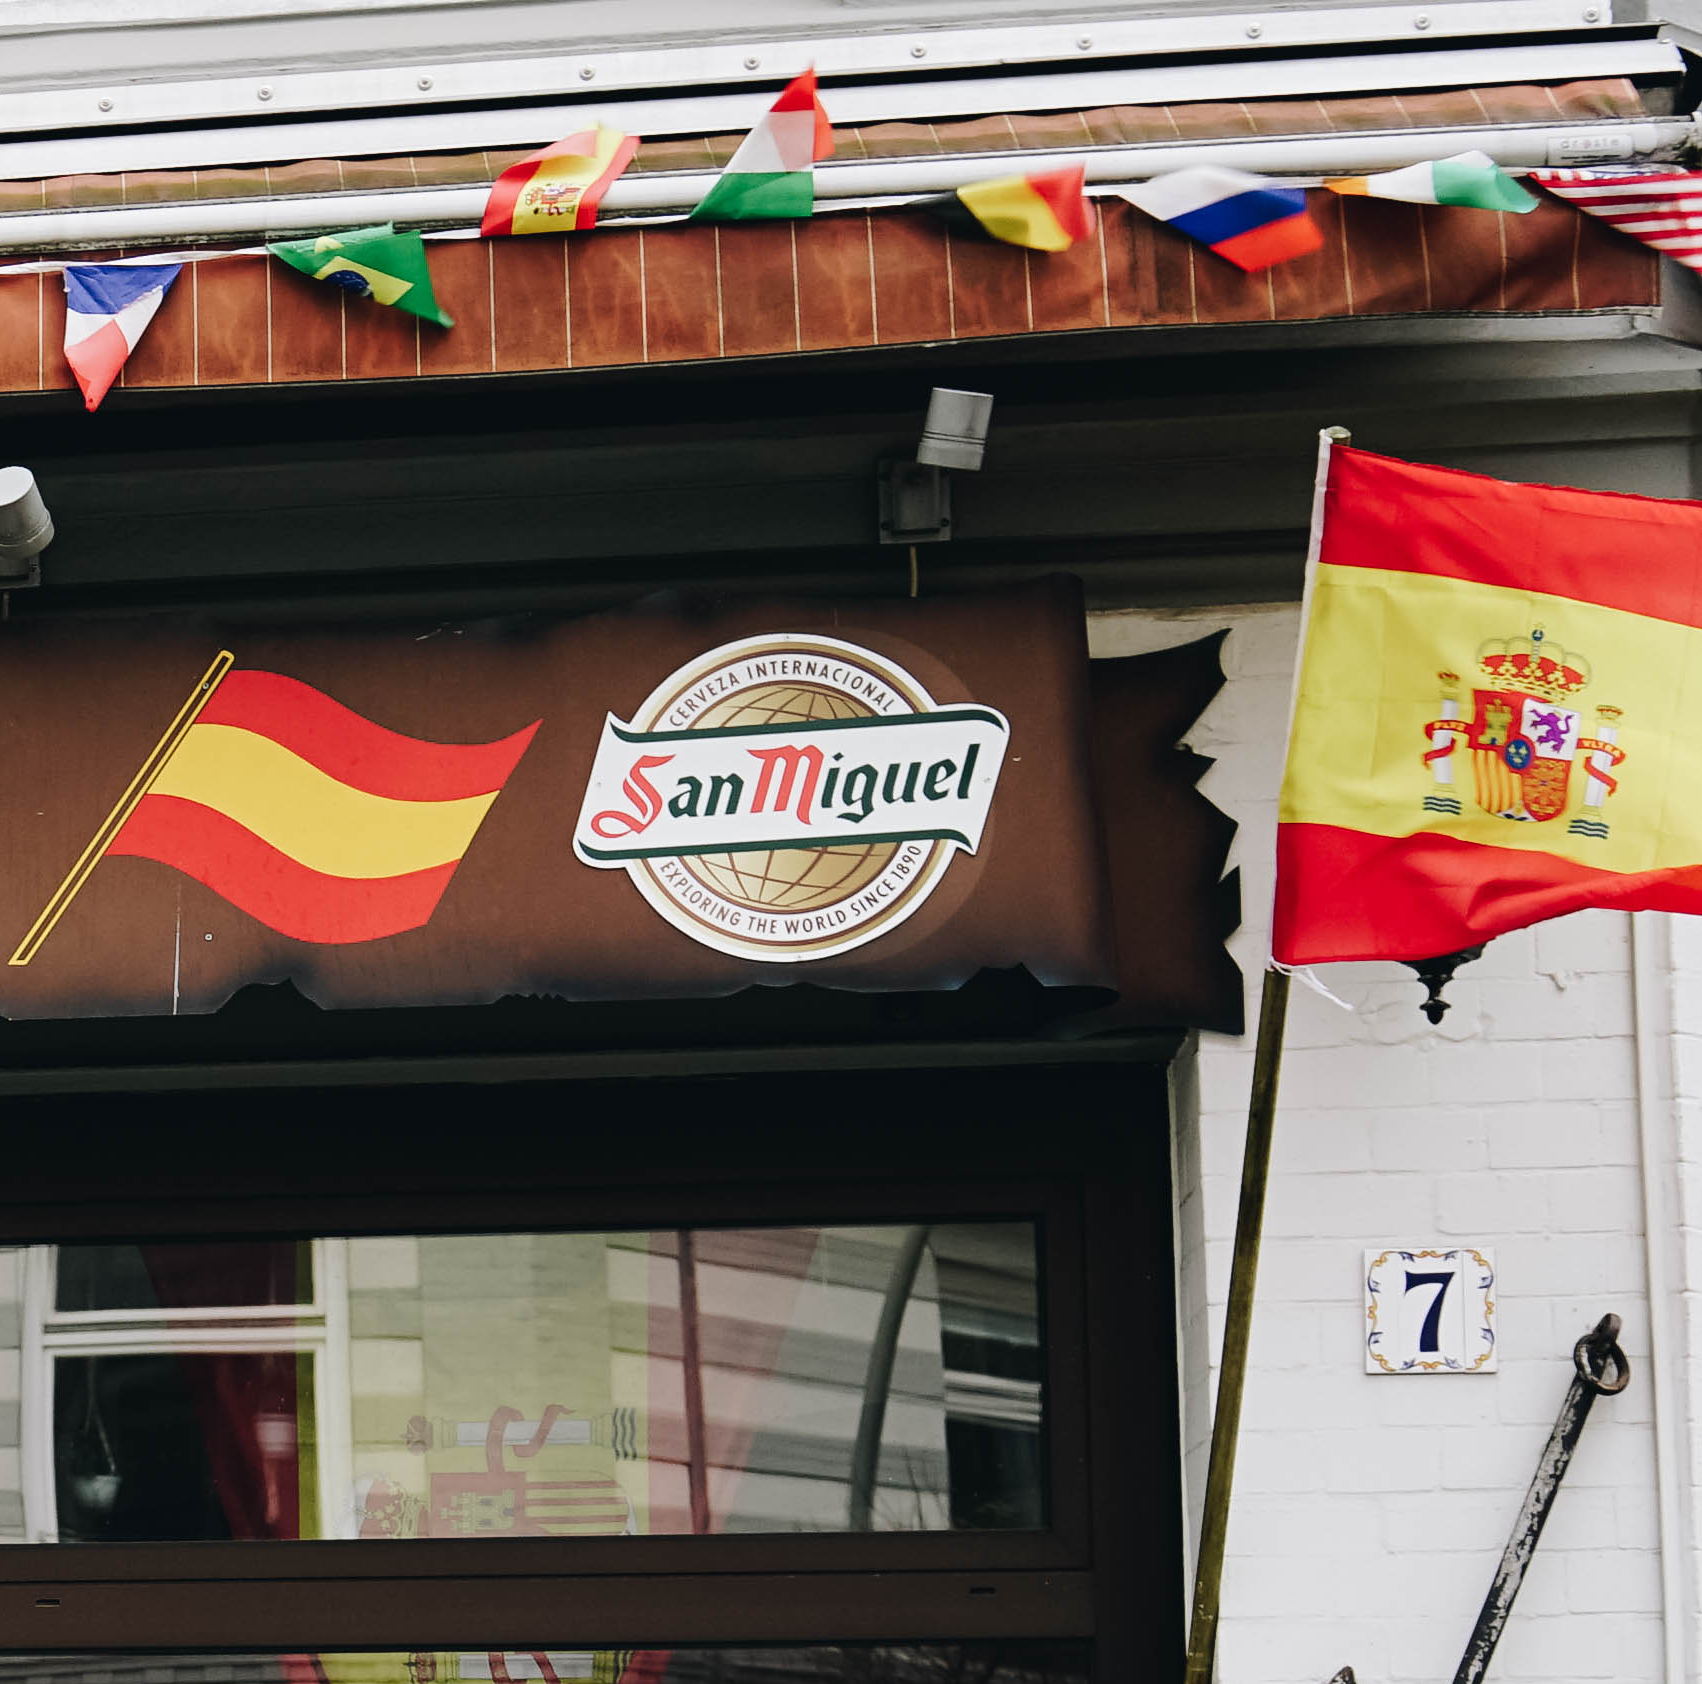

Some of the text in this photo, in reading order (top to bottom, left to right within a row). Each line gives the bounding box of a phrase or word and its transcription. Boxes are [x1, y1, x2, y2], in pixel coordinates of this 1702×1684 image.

[669, 660, 896, 727] CERVEZA INTERNACIONAL
[659, 845, 923, 935] EXPLORING THE WORLD SINCE 1890
[1404, 1270, 1456, 1353] 7
